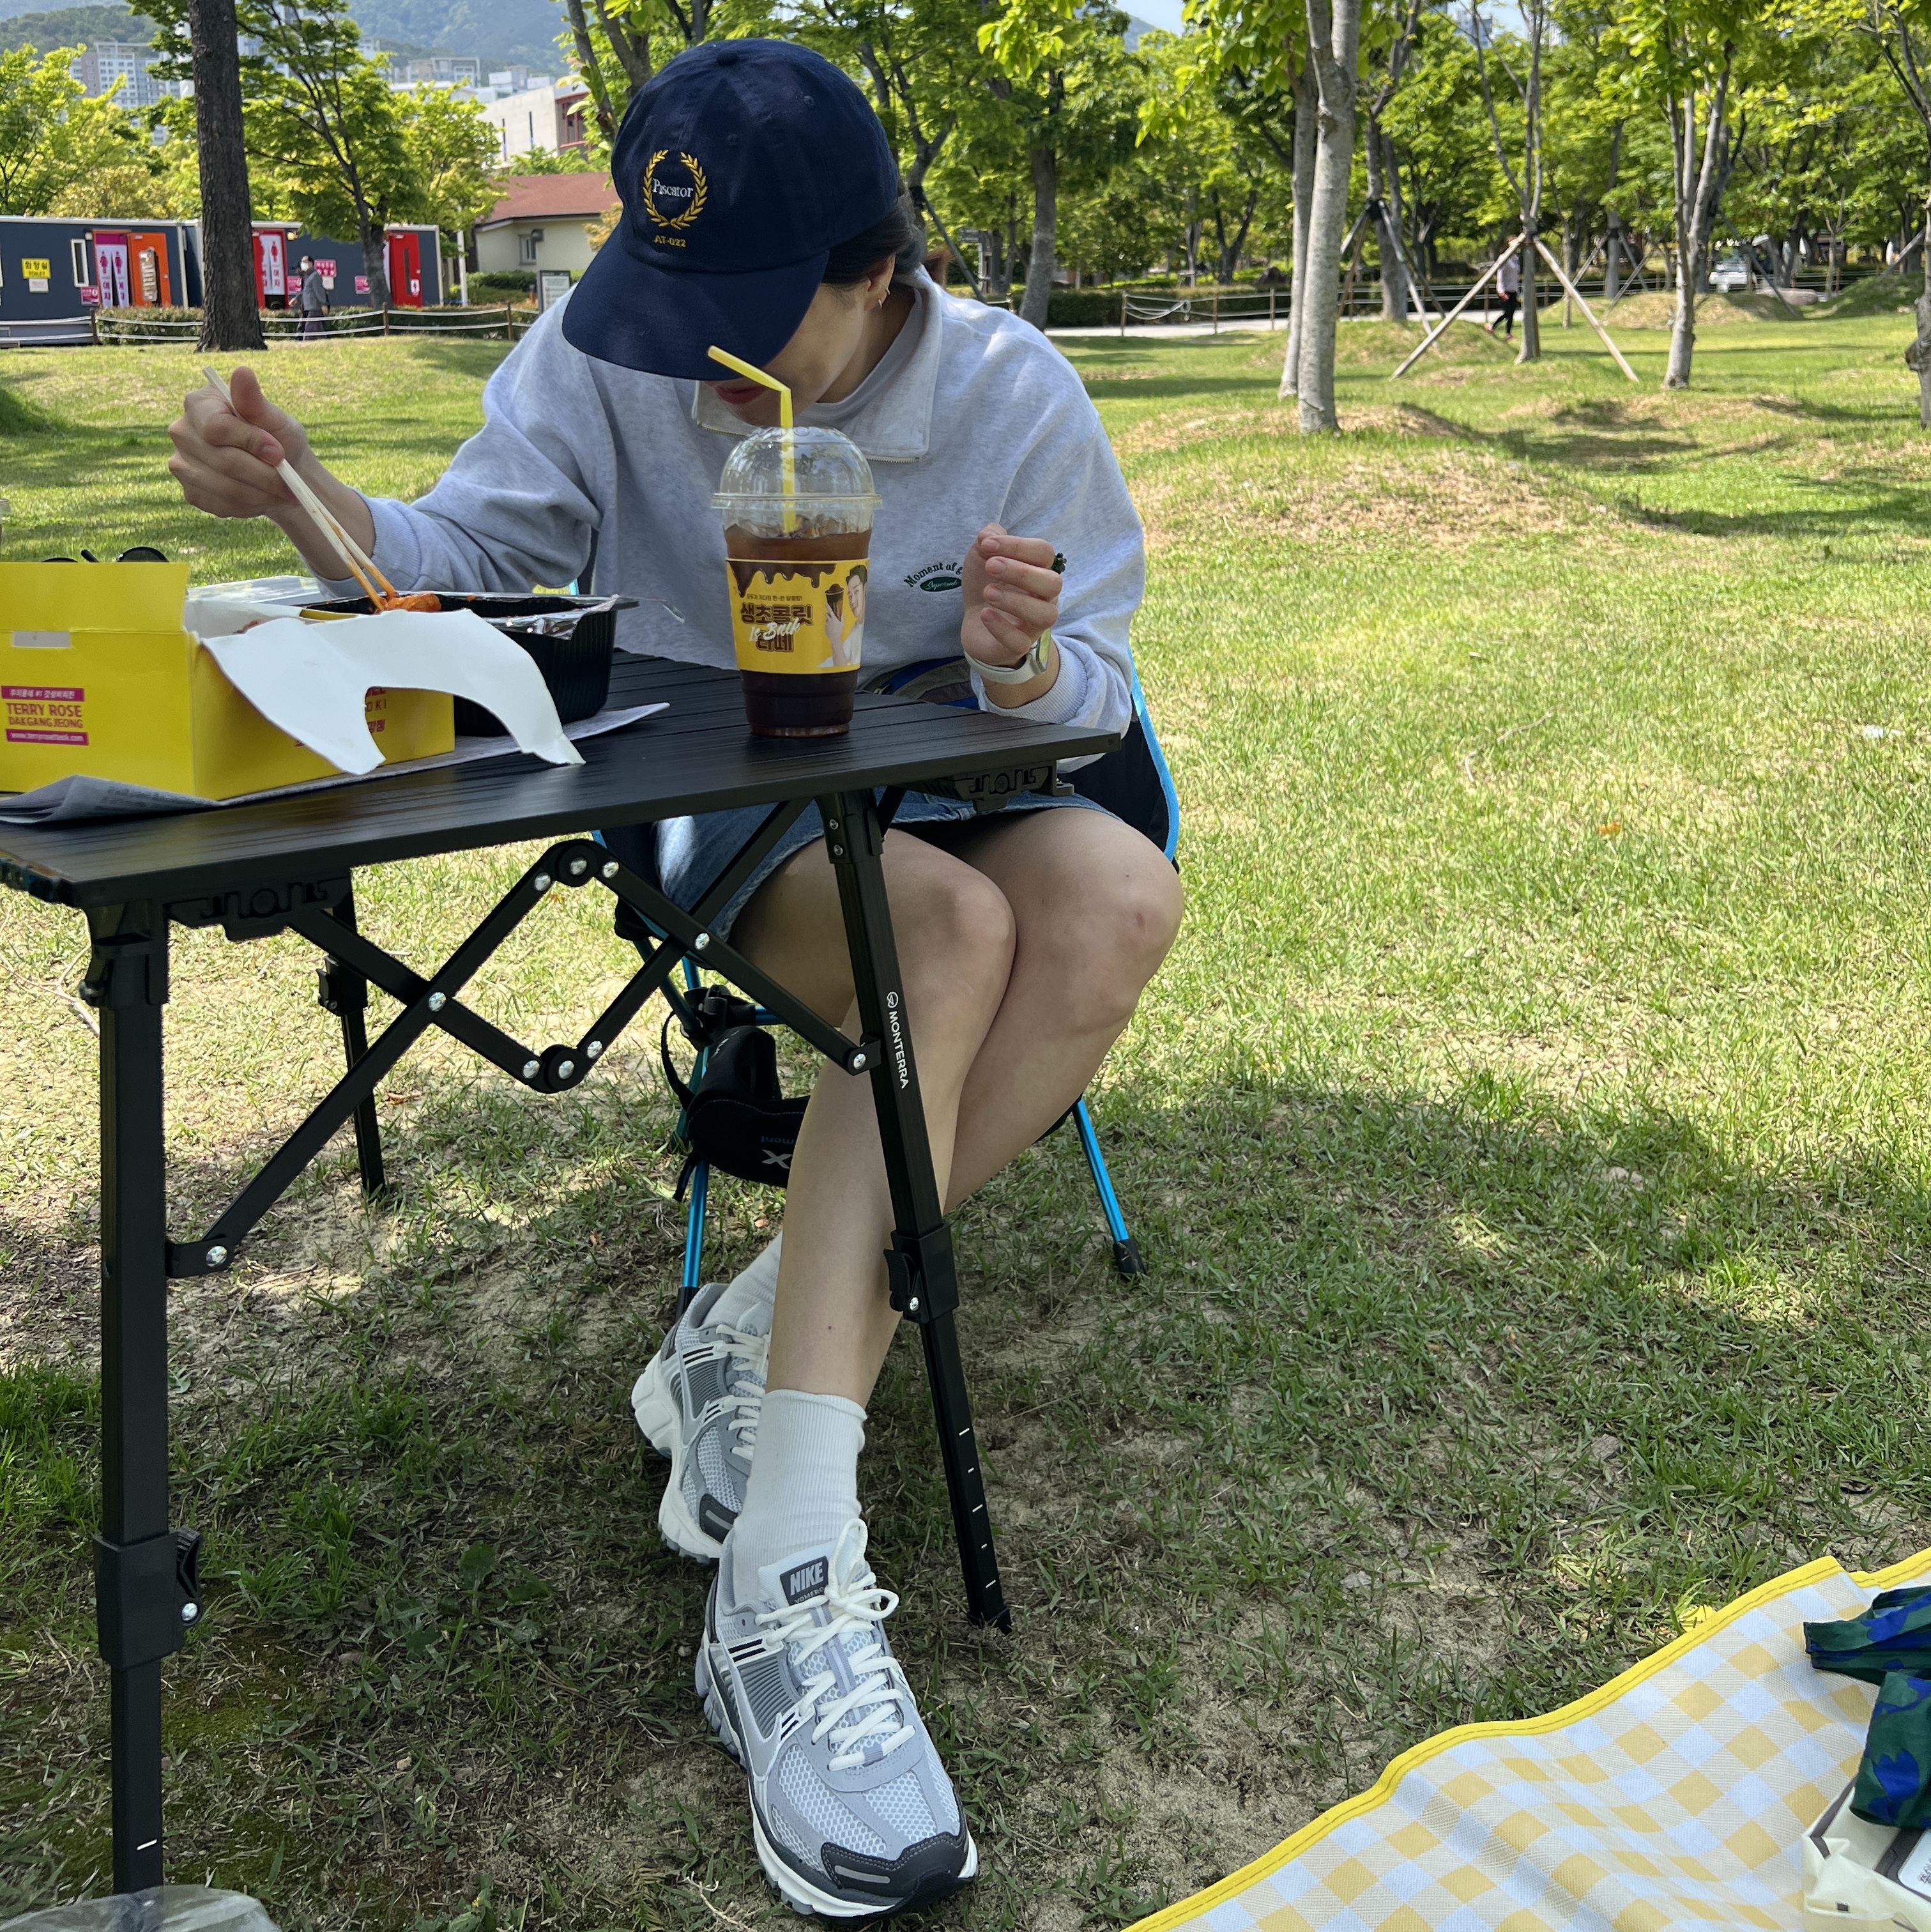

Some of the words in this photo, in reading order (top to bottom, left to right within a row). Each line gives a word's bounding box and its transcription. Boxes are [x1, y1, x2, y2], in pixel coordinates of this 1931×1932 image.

[653, 178, 694, 197] Piscator
[25, 261, 47, 271] 화장실
[904, 562, 943, 588] Moment
[945, 562, 958, 571] of
[741, 602, 814, 626] 생초콜릿
[763, 617, 801, 641] Back
[6, 703, 45, 716] TERRY
[48, 704, 82, 717] ROSE
[889, 1011, 909, 1089] MONTERRA
[790, 1561, 824, 1596] NIKE
[794, 1586, 825, 1604] VOMERO
